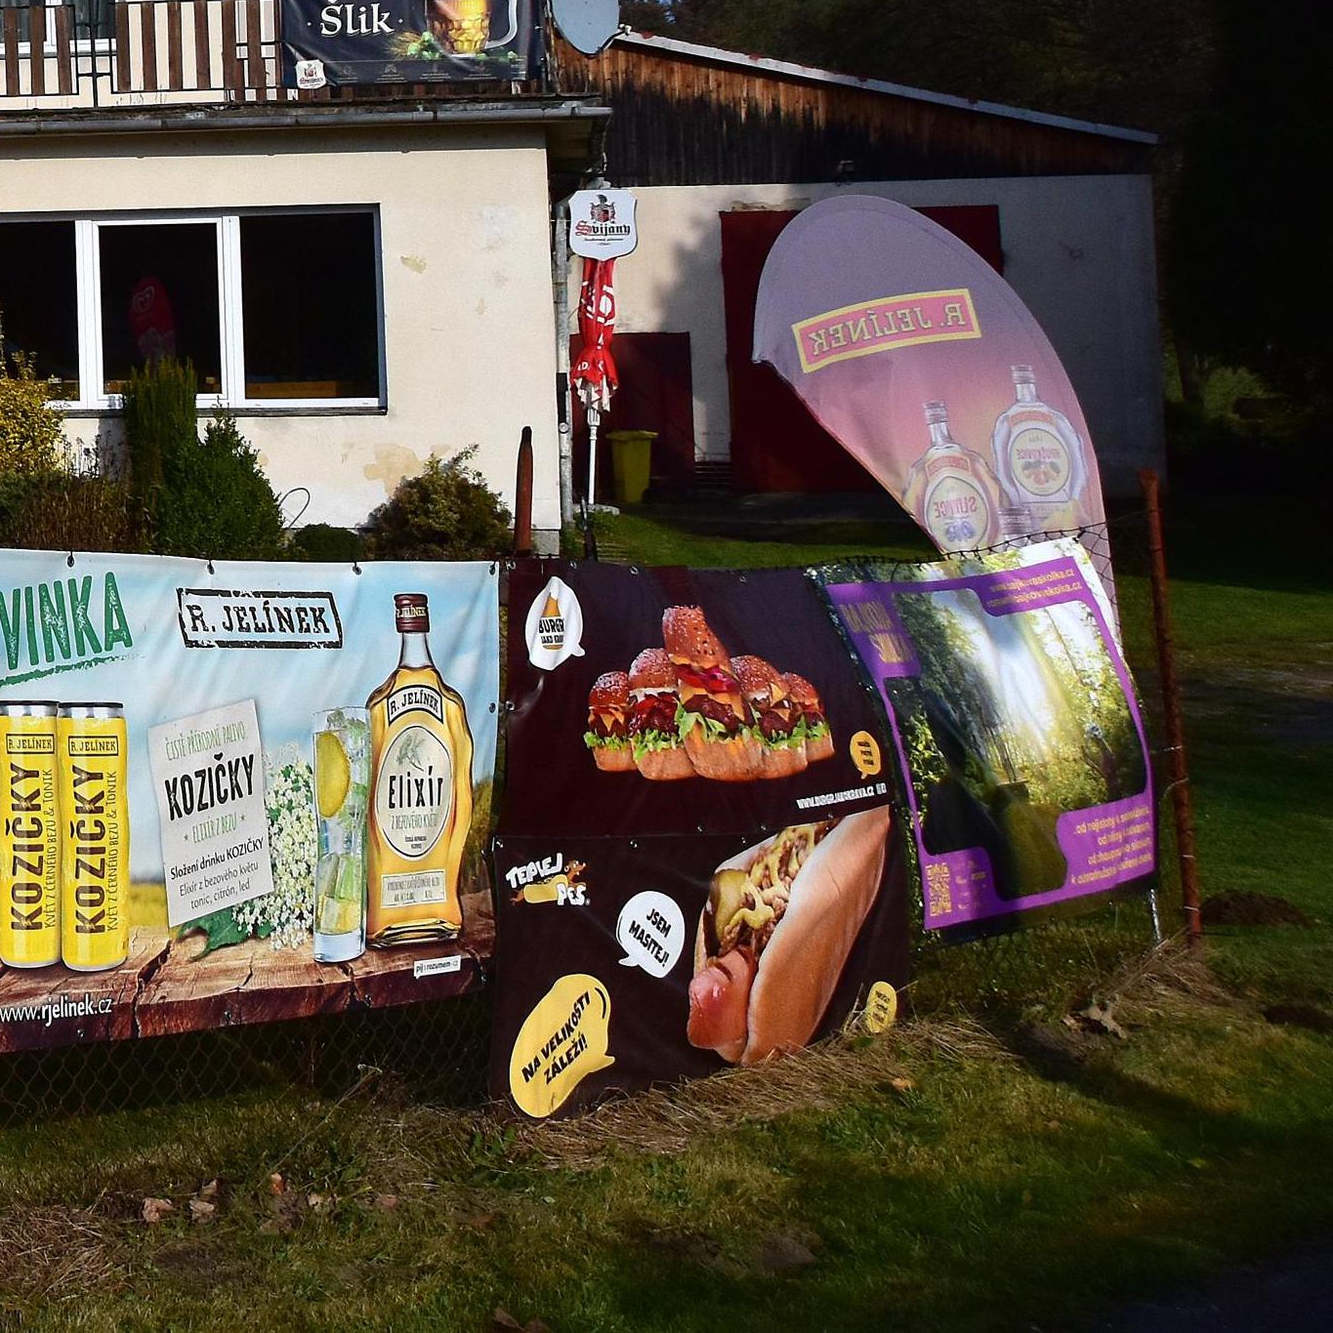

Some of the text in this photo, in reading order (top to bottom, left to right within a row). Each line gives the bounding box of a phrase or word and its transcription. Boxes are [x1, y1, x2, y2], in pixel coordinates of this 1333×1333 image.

[575, 220, 630, 236] Svijany
[189, 599, 331, 634] R. JELÍNEK
[389, 689, 439, 716] R. JELÍNEK
[9, 737, 53, 751] R. JELÍNEK
[70, 739, 117, 752] R. JELÍNEK
[42, 769, 54, 804] TONIK
[105, 771, 117, 806] TONIK
[164, 752, 254, 821] KOZIČKY
[388, 765, 443, 809] Elixír
[44, 806, 55, 817] &
[106, 809, 117, 820] &
[5, 762, 45, 930] KOZIČKY
[43, 819, 57, 843] BEZU
[107, 822, 119, 846] BEZU
[69, 764, 106, 934] KOZIČKY
[170, 837, 264, 880] Složení drinku KOZIČKY
[43, 846, 57, 891] ČERNÉHO
[105, 848, 118, 894] ČERNÉHO
[179, 860, 259, 897] Elixír z bezového květu
[505, 852, 563, 889] TEPLEJ
[190, 878, 251, 910] tonic, citrón, led
[556, 883, 586, 906] PES
[43, 903, 56, 929] KVĚT
[106, 905, 118, 932] KVĚT
[646, 908, 672, 938] JSEM
[629, 920, 670, 968] MASITEJ!
[0, 994, 112, 1027] www.rjelinek.cz
[540, 991, 591, 1060] VELIKOSTI
[521, 1057, 541, 1083] NA
[544, 1032, 588, 1086] ZÁLEŽÍ!
